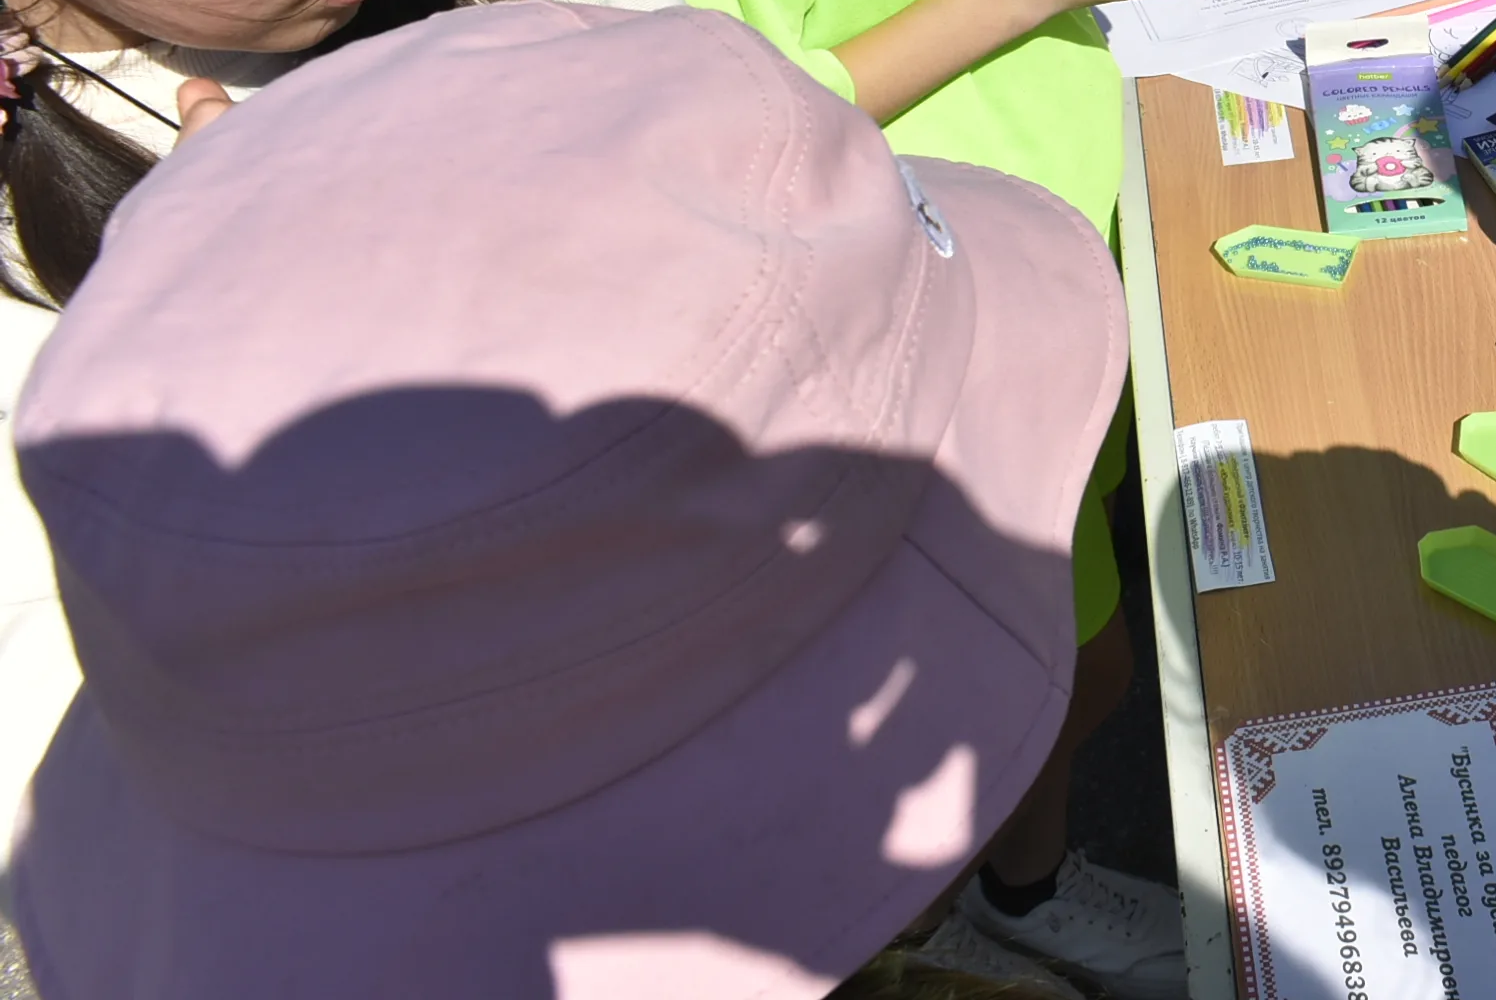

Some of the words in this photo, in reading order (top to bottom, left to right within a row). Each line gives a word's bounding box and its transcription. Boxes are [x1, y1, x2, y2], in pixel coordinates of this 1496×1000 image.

[1323, 85, 1378, 97] COLORED
[1382, 85, 1431, 93] PENCILS
[1390, 215, 1426, 223] цветов
[1188, 517, 1201, 550] WhatsApp
[1250, 509, 1263, 545] творчества
[1312, 788, 1332, 836] тел.
[1450, 746, 1486, 845] "Бусинка
[1475, 851, 1495, 877] за
[1381, 836, 1419, 958] Васильева
[1397, 774, 1425, 839] Алена
[1412, 845, 1460, 1000] Владимировн
[1441, 834, 1473, 917] педагог
